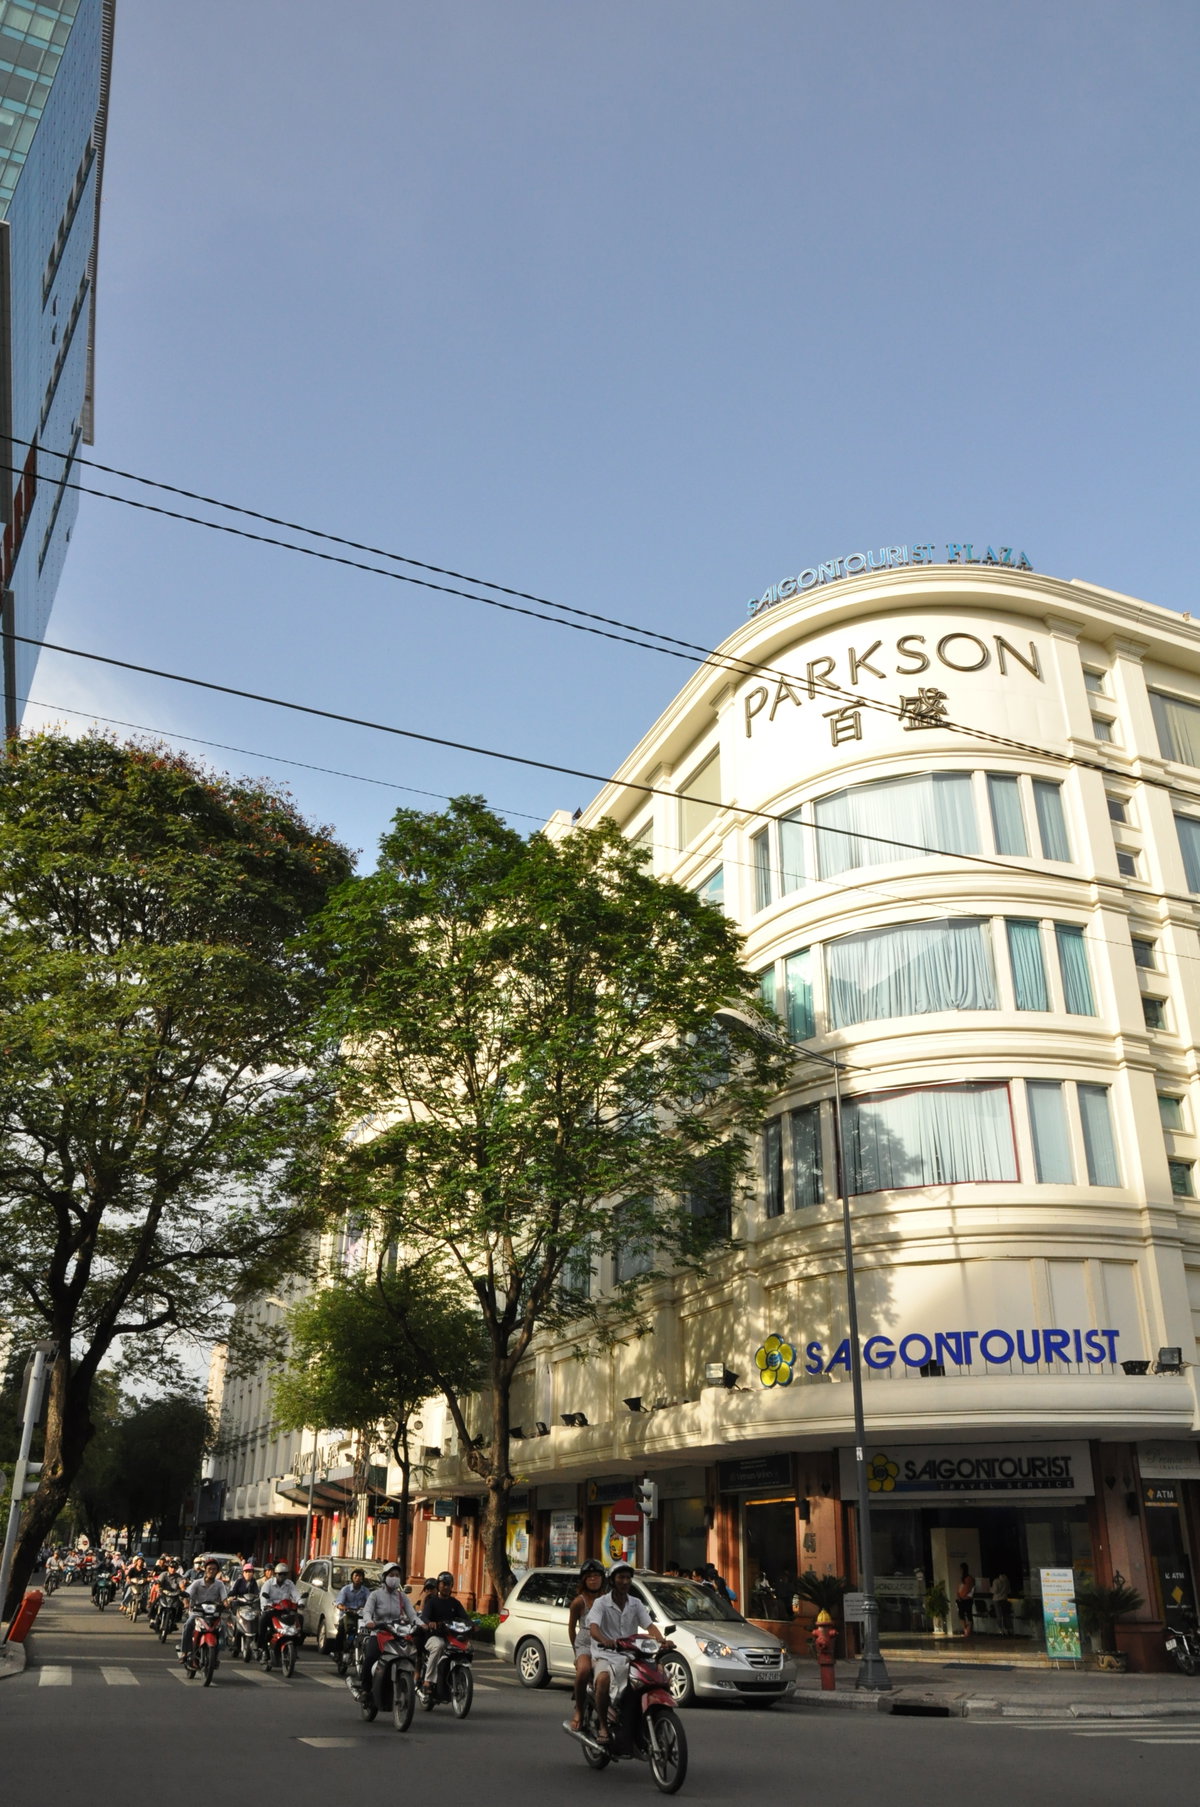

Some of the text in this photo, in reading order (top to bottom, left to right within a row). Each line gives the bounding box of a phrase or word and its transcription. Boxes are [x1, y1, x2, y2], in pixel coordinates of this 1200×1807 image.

[746, 543, 1033, 616] SAIGONTOURIST PLAZA
[744, 632, 1044, 738] PARKSON
[822, 687, 950, 746] 百盛
[806, 1329, 1120, 1374] SAGONTOURIST
[904, 1456, 1072, 1480] SAIGONTOURIST
[939, 1480, 1072, 1490] TRAVEL SERVICE
[1156, 1490, 1173, 1498] ATM
